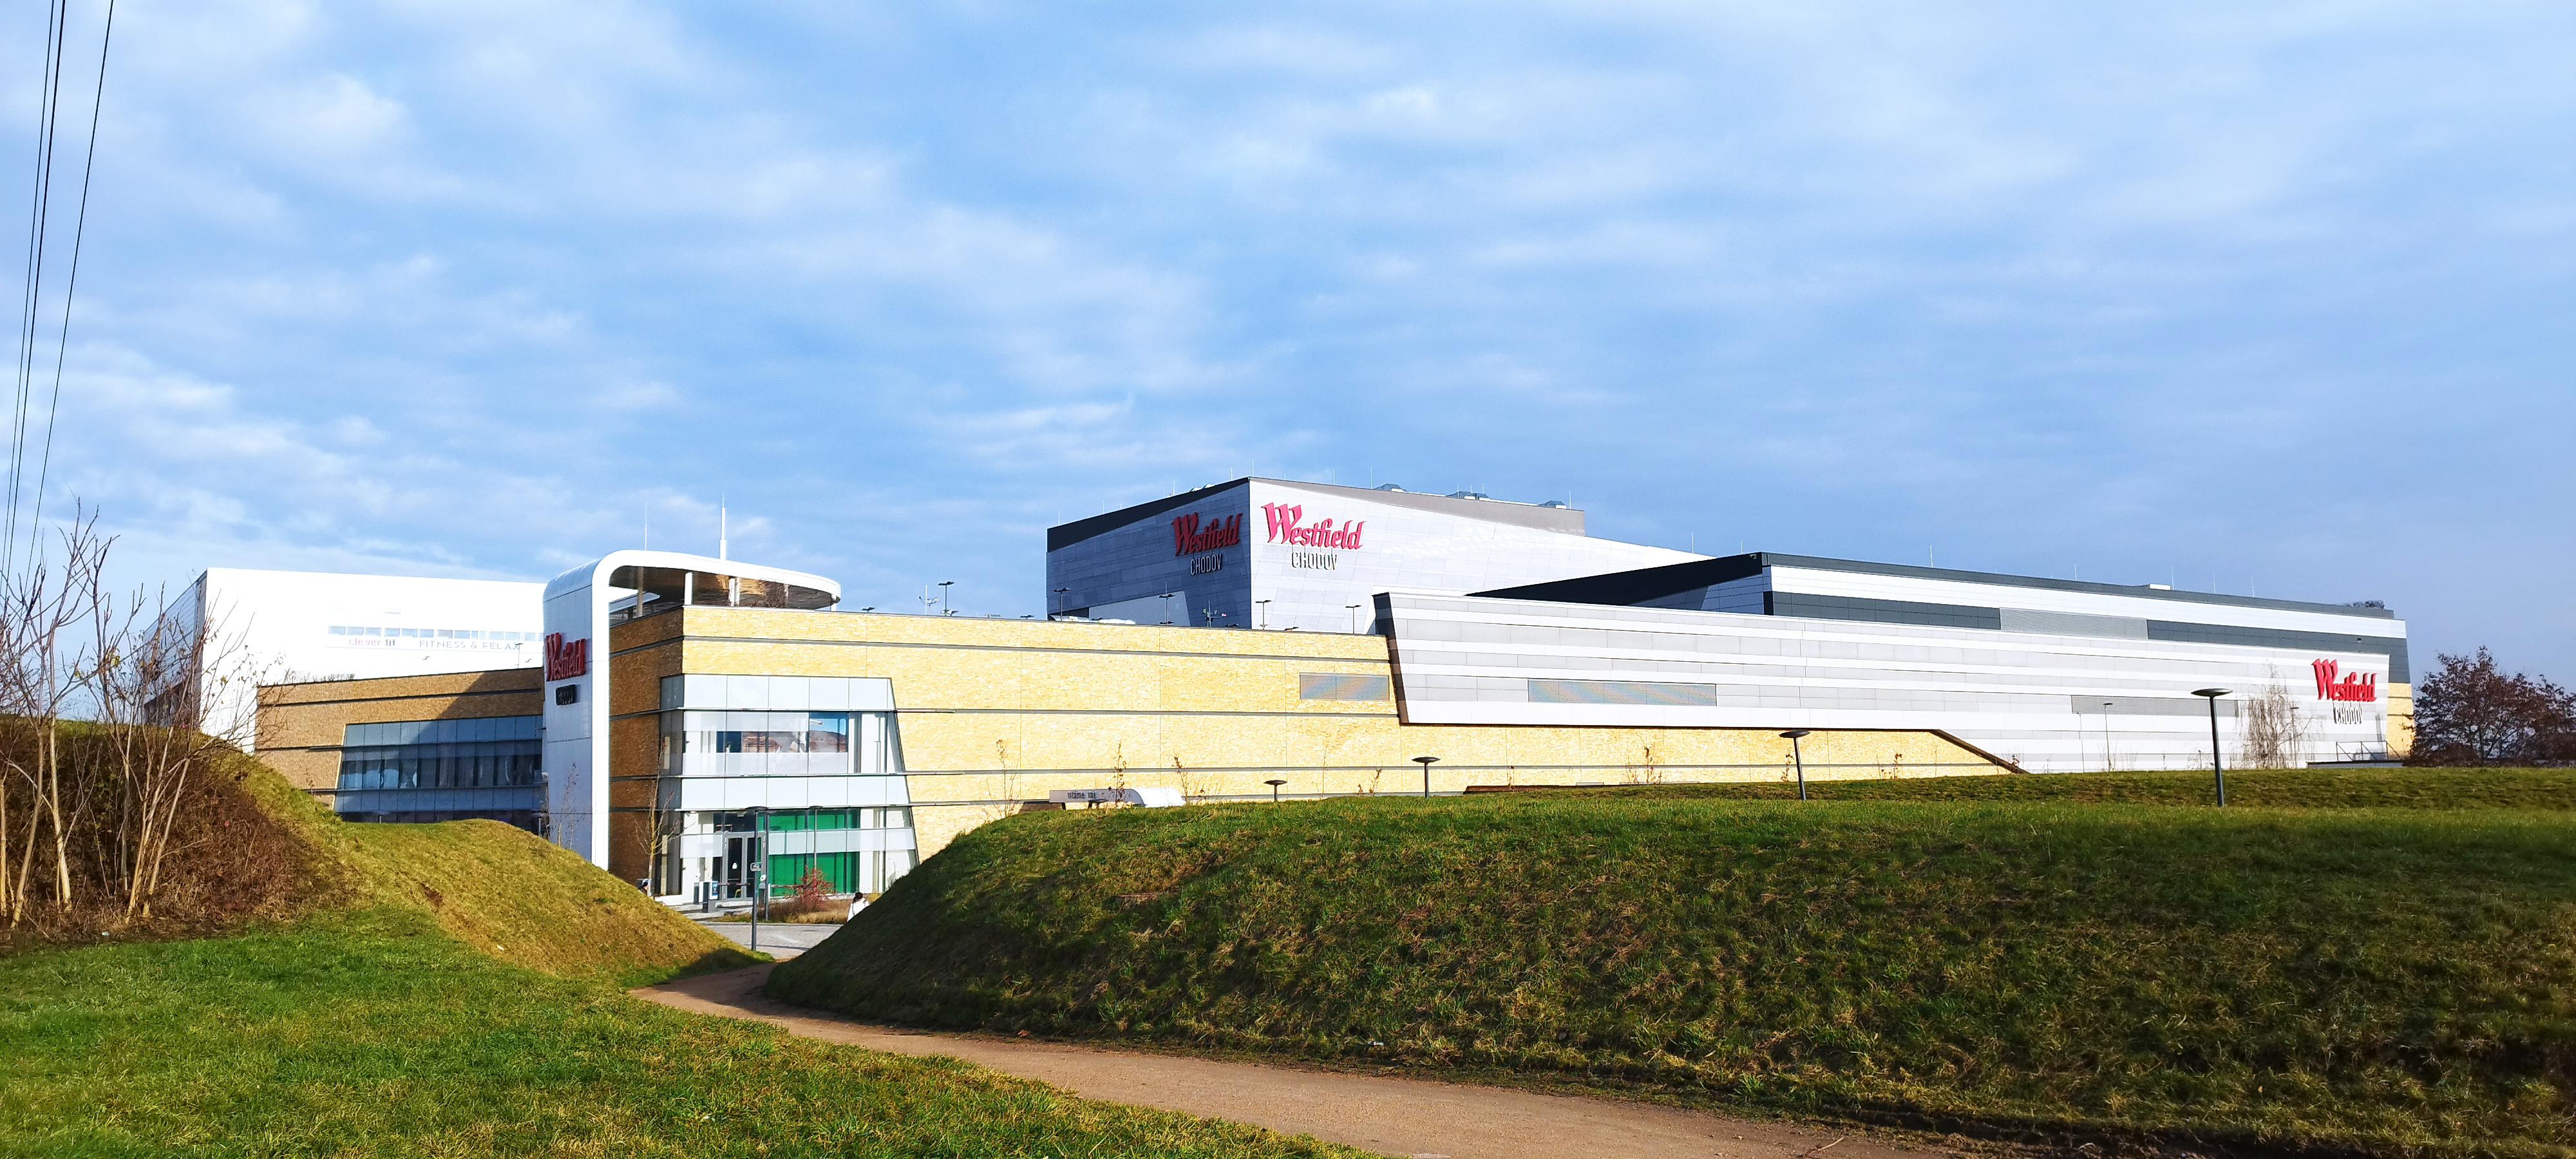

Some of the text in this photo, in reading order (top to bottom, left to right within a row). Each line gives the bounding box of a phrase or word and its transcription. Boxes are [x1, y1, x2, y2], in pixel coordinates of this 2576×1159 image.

[1171, 511, 1243, 556] Westfield
[1260, 502, 1366, 550] Westfield
[1190, 554, 1222, 575] CHODOV
[1291, 551, 1338, 570] CHODOV
[419, 640, 466, 650] FITNESS
[545, 632, 587, 683] Westfield
[2311, 658, 2378, 702] Westfield
[2333, 707, 2364, 725] CHODOV
